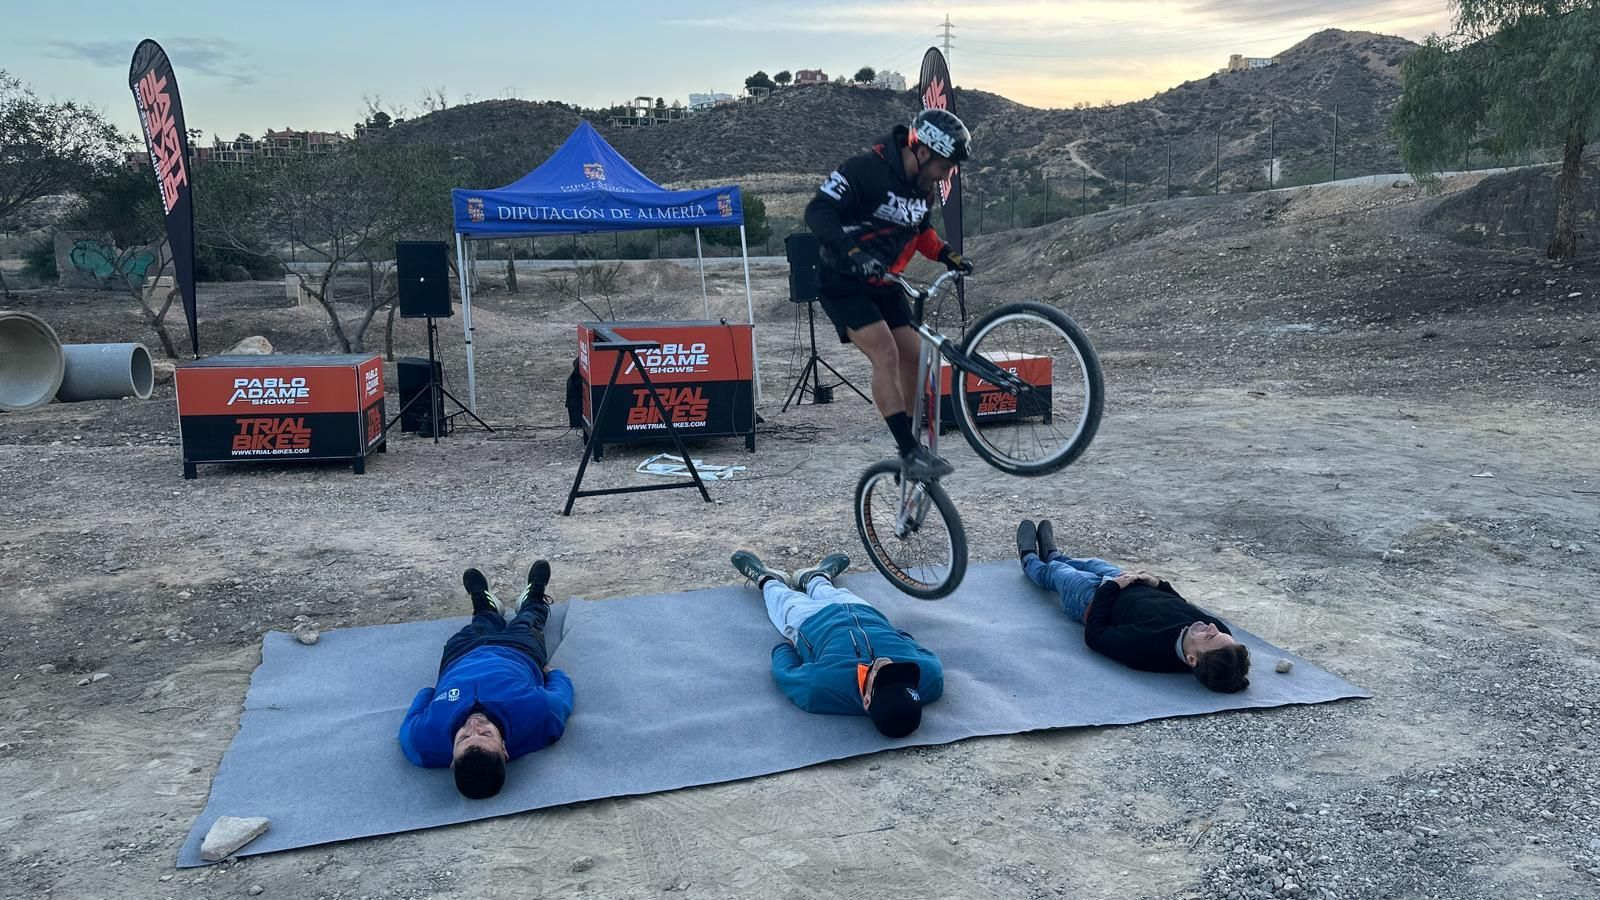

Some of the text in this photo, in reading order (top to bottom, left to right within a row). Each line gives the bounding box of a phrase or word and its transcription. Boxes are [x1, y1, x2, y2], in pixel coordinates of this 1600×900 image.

[920, 120, 955, 149] TRIAL
[497, 202, 707, 220] DIPUTACIÓN DE ALMERÍA
[650, 366, 694, 374] SHOWS
[234, 377, 306, 389] PABLO
[226, 387, 310, 406] ADAME
[633, 387, 709, 406] TRIAL
[979, 400, 1016, 412] BIKES
[236, 417, 312, 434] TRIAL
[232, 433, 311, 450] BIKES
[231, 448, 310, 456] WWW.TRIAL-BIKES.COM
